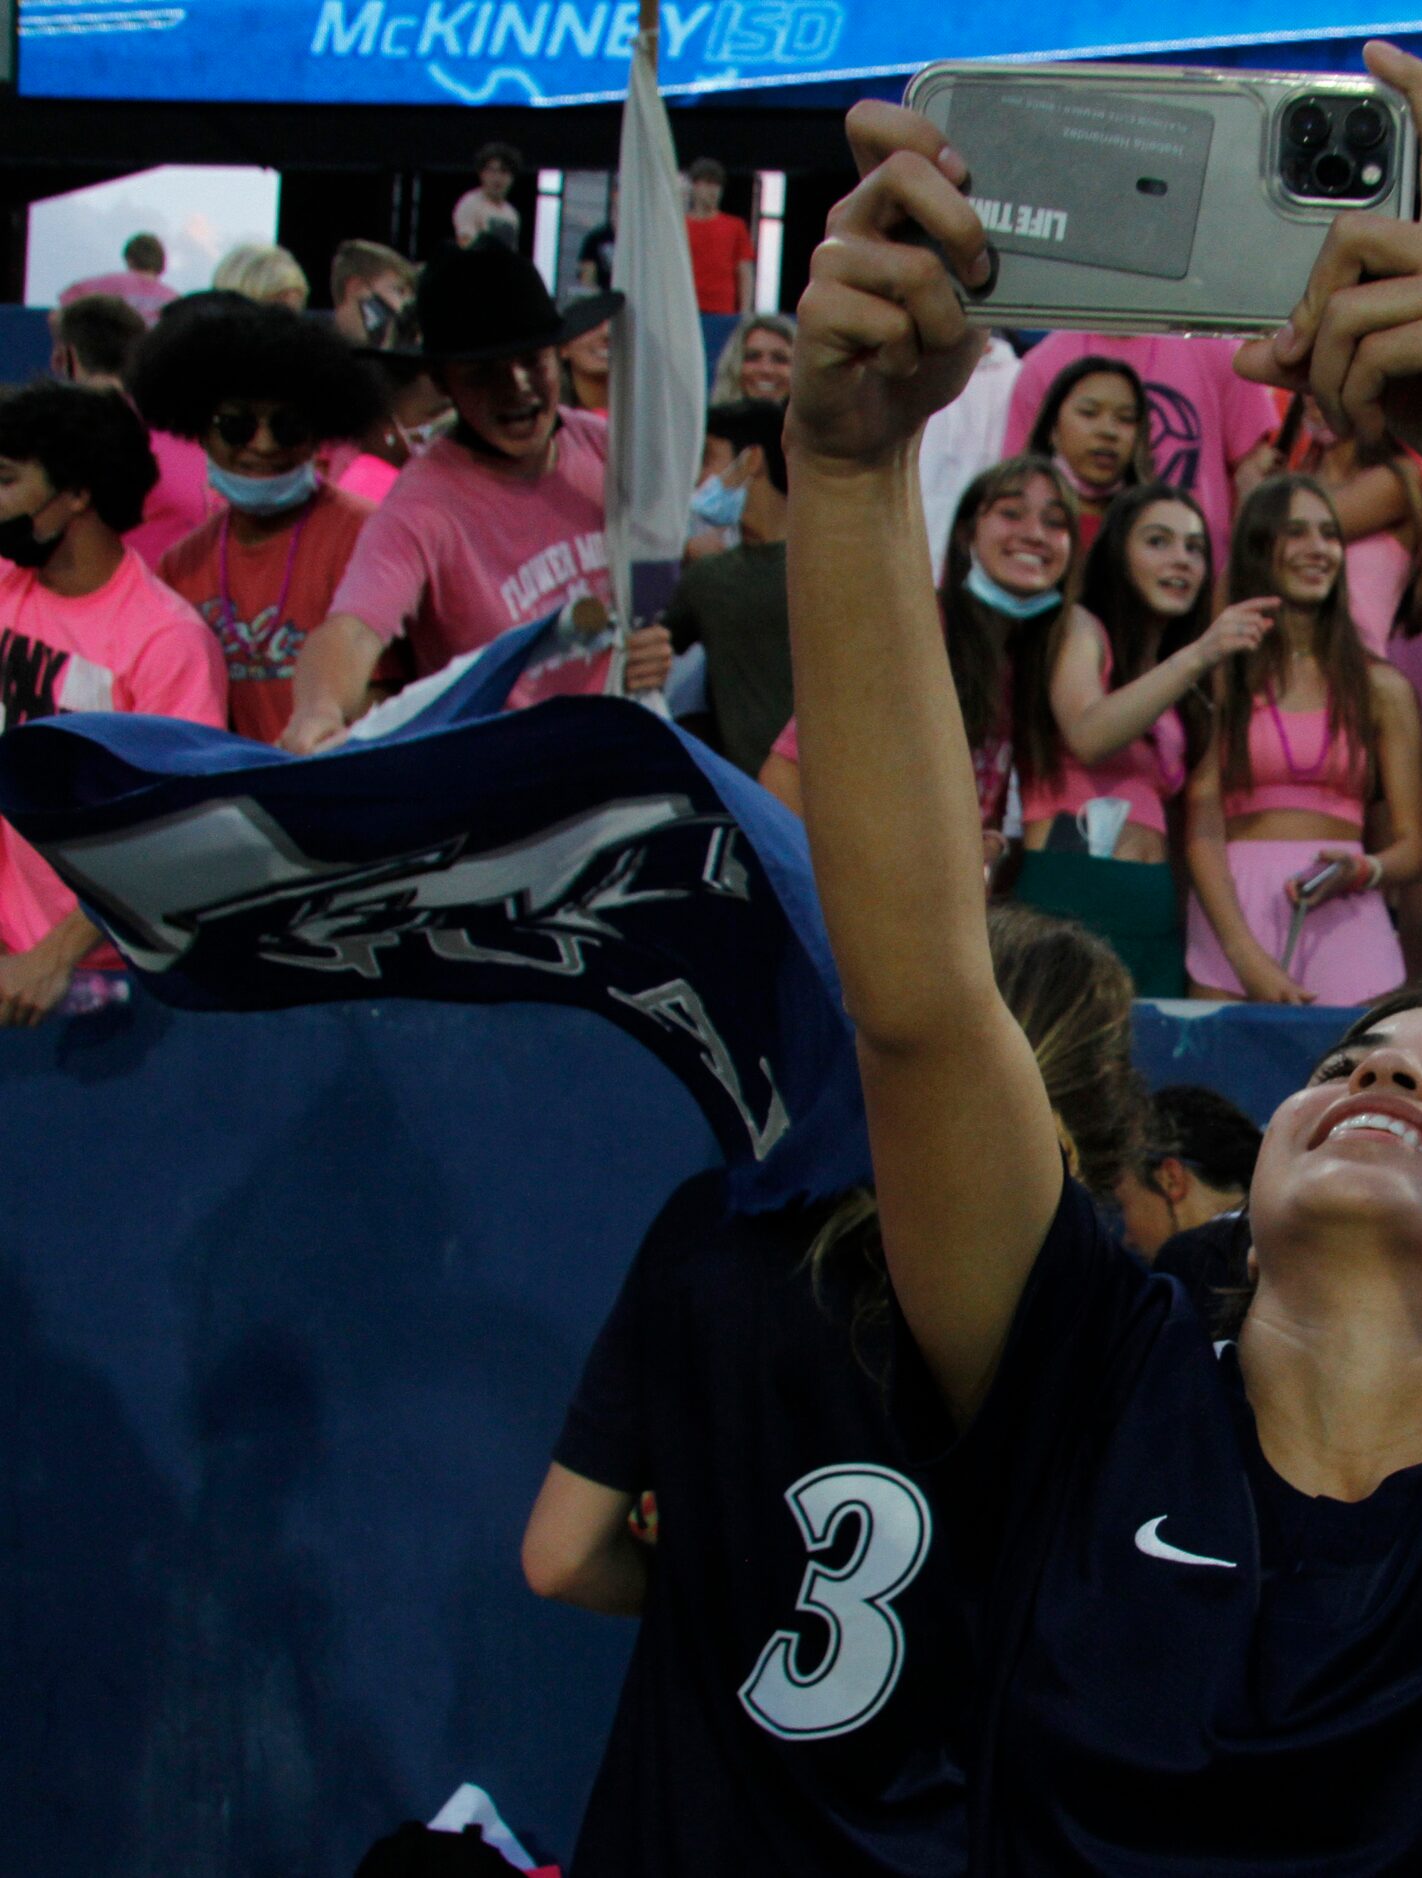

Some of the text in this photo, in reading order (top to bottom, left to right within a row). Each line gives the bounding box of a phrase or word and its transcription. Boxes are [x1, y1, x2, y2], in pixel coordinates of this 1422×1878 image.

[707, 0, 845, 63] ISD
[970, 198, 1068, 242] LIFE TIM
[738, 1462, 932, 1741] 3
